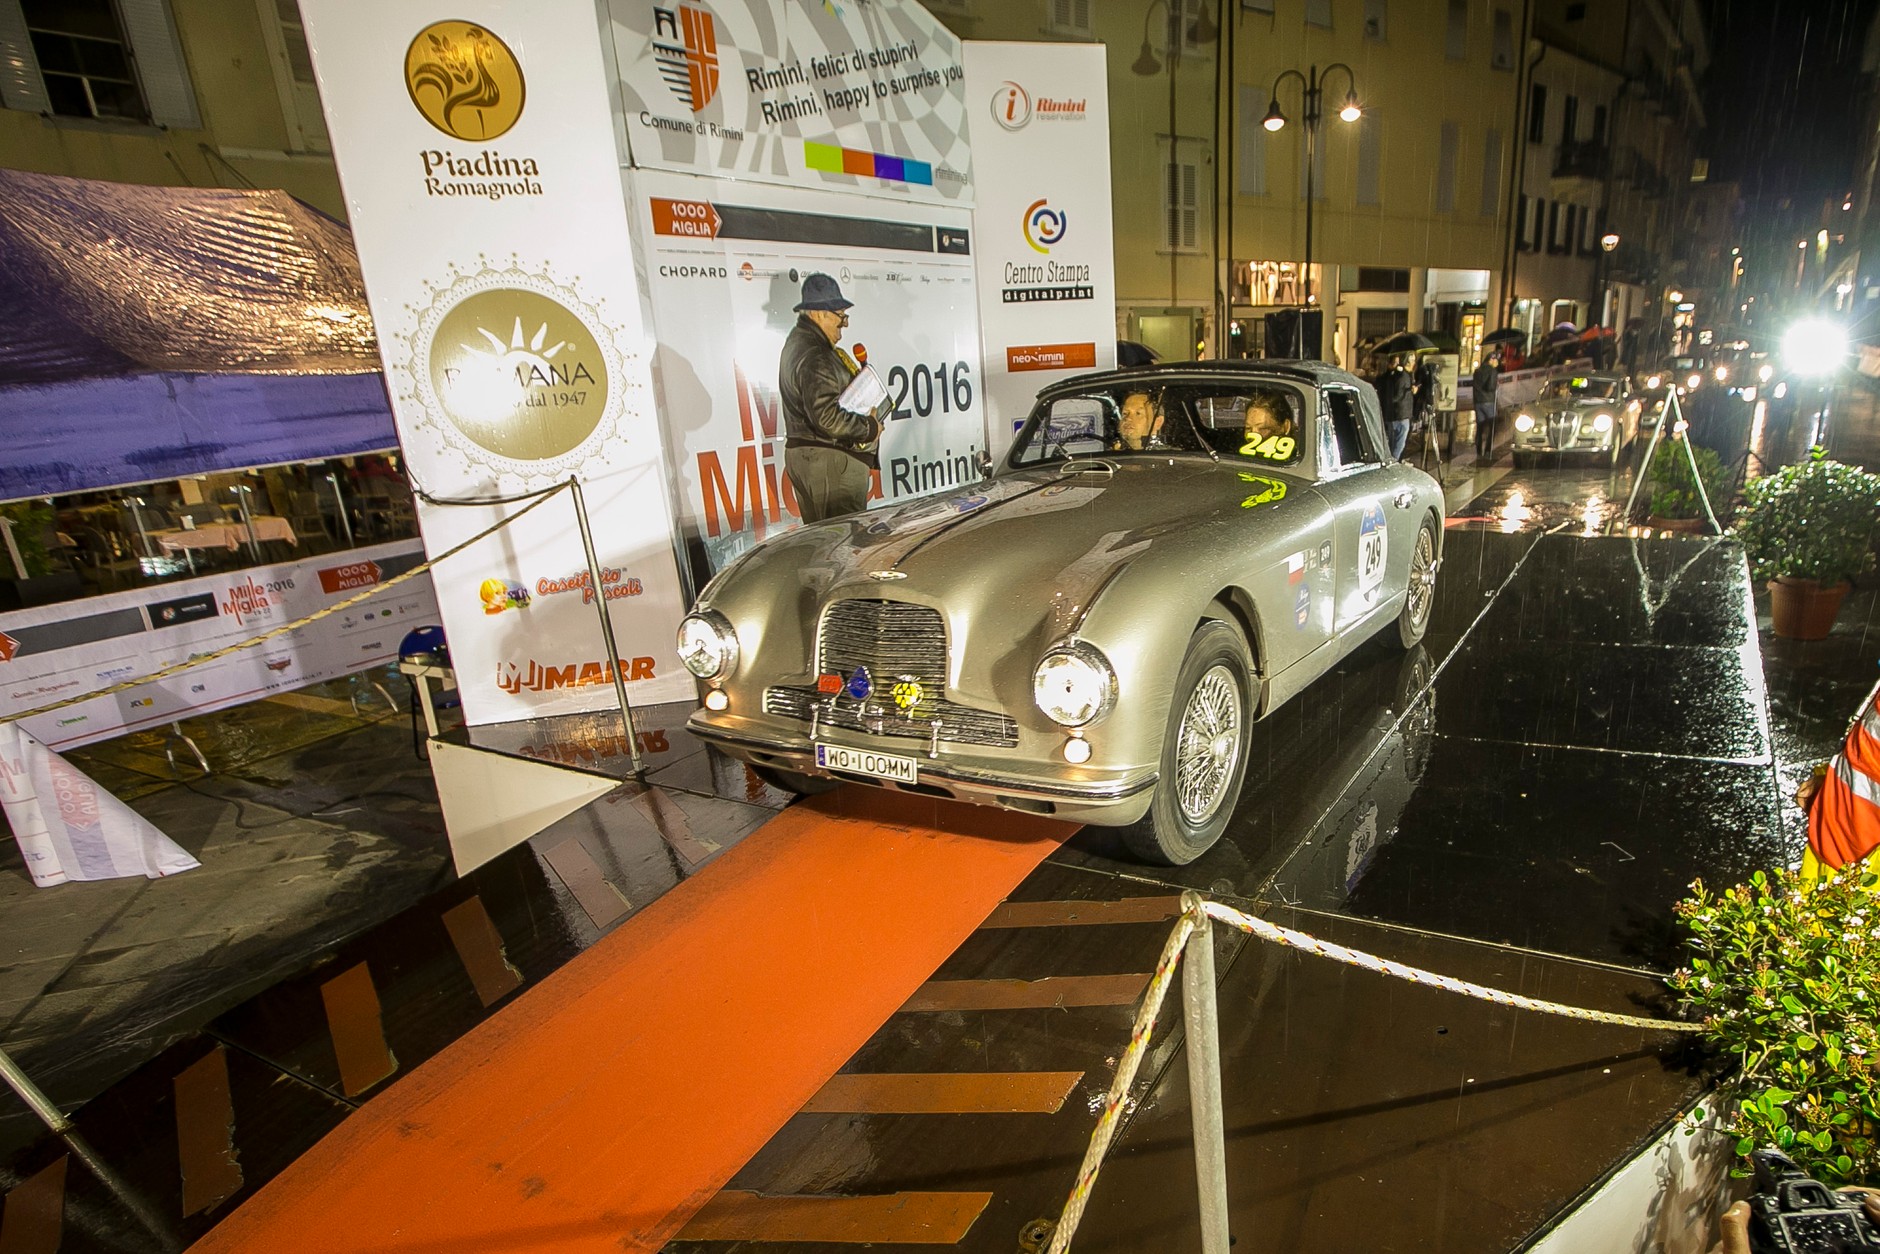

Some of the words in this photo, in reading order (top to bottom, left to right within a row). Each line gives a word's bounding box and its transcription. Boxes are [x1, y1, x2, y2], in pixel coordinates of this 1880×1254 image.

[746, 60, 810, 93] Rimini,
[811, 52, 850, 80] felici
[852, 49, 867, 72] di
[869, 40, 919, 69] stupirvi
[761, 92, 823, 125] Rimini,
[823, 85, 870, 111] happy
[873, 80, 888, 99] to
[890, 67, 941, 95] surprise
[942, 64, 964, 87] you
[1036, 98, 1087, 112] Rimini
[640, 111, 693, 134] Comune
[696, 121, 706, 135] di
[710, 123, 744, 142] Rimini
[419, 150, 539, 176] Piadina
[424, 177, 543, 201] Romagnola
[671, 203, 707, 218] 1000
[671, 220, 712, 236] MIGLIA
[659, 265, 728, 279] CHOPARD
[1004, 261, 1044, 285] Centro
[1047, 260, 1090, 288] Stampa
[525, 392, 547, 408] dal
[553, 390, 587, 407] 1947
[888, 360, 973, 422] 2016
[1239, 432, 1296, 460] 249
[890, 444, 978, 498] Rimini
[1365, 535, 1381, 576] 249
[336, 564, 369, 577] 1000
[338, 575, 375, 590] MIGLIA
[229, 575, 265, 601] Mille
[266, 578, 295, 593] 2016
[582, 577, 644, 605] Pscoli
[222, 597, 269, 626] Miglia
[545, 656, 657, 690] MARR
